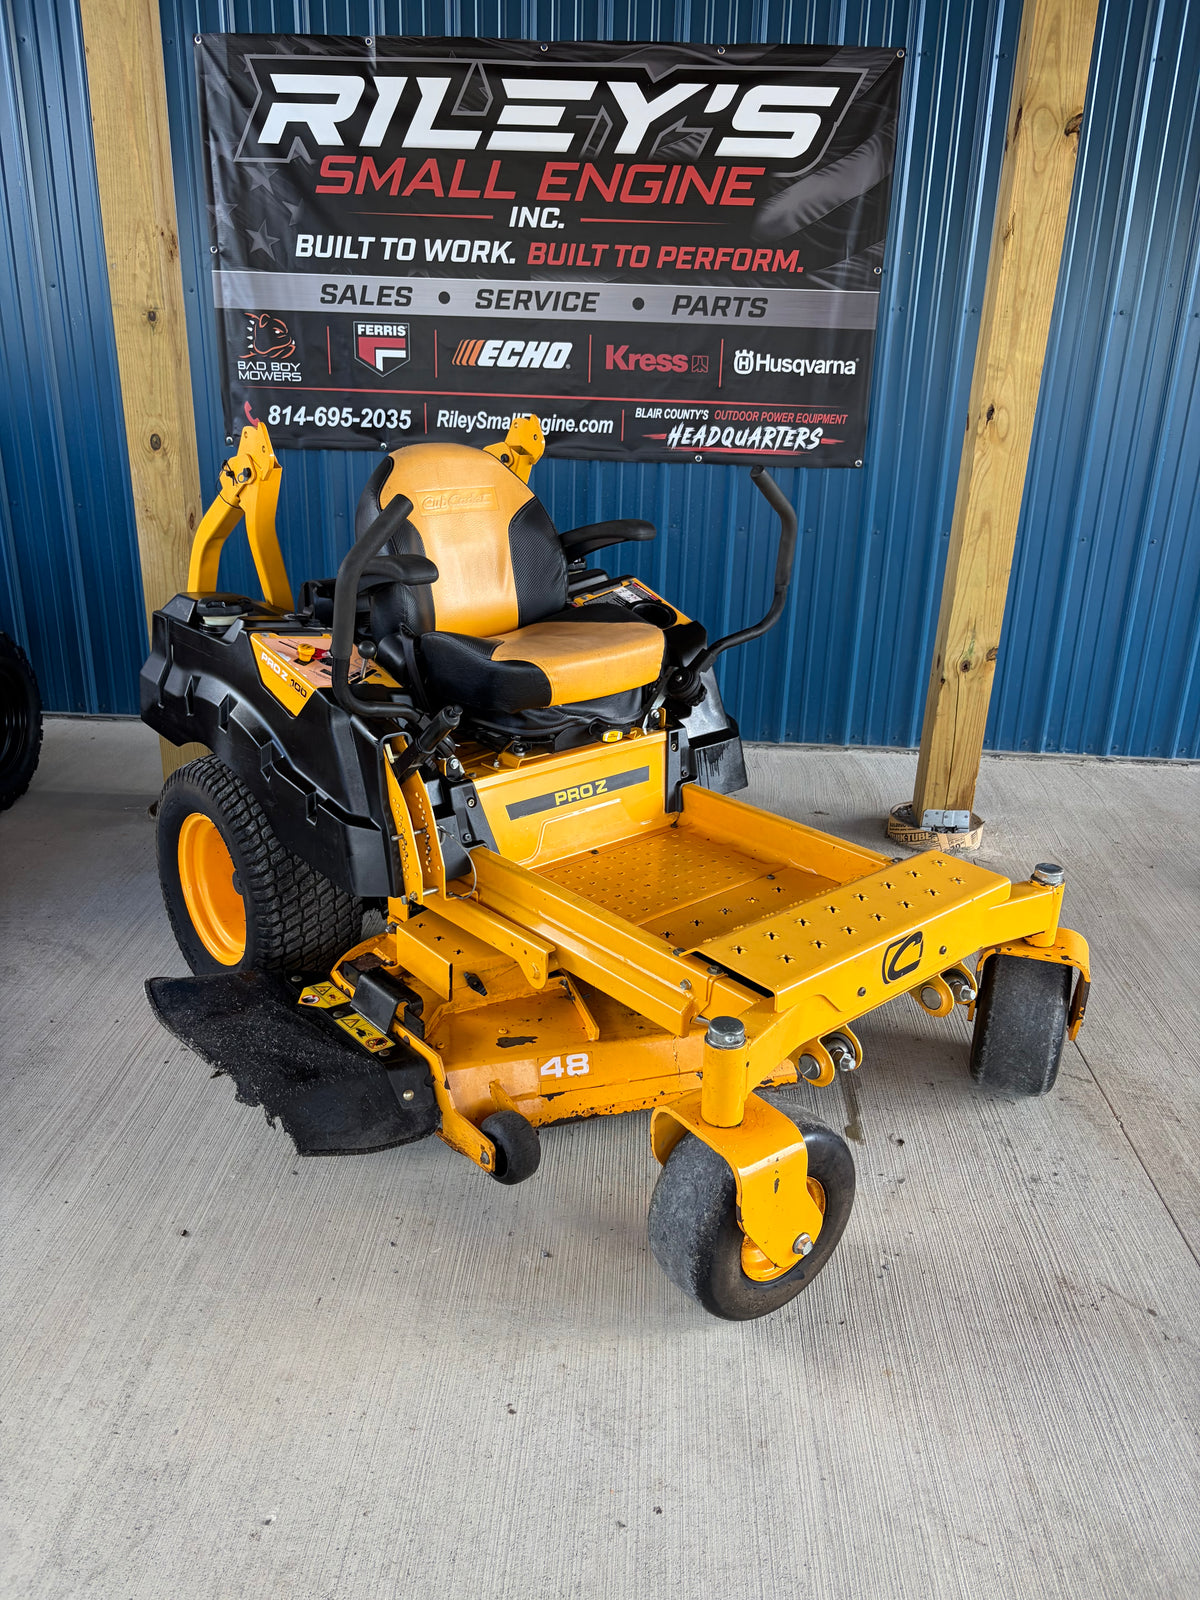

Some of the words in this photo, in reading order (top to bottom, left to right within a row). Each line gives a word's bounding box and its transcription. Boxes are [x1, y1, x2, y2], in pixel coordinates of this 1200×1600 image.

[257, 73, 841, 159] RILEY'S
[315, 155, 516, 200] SMALL
[535, 161, 766, 207] ENGINE
[509, 206, 565, 229] INC.
[295, 233, 376, 260] BUILT
[380, 237, 417, 261] TO
[424, 238, 516, 265] WORK.
[526, 242, 610, 267] BUILT
[614, 244, 651, 268] TO
[656, 245, 804, 273] PERFORM.
[319, 283, 413, 308] SALES
[474, 287, 600, 313] SERVICE
[671, 294, 769, 318] PARTS
[356, 323, 407, 338] FERRIS
[237, 360, 268, 372] BAD
[270, 362, 301, 374] BOY
[476, 338, 573, 370] ECHO
[605, 344, 688, 373] Kress
[755, 353, 856, 377] Husqvarna
[238, 370, 302, 383] MOWERS
[267, 404, 412, 431] 814-695-2035
[436, 409, 614, 436] RileySmagine.com
[634, 407, 662, 419] BLAIR
[663, 408, 710, 421] COUNTY'S
[714, 409, 760, 422] OUTDOOR
[760, 411, 795, 423] POWER
[795, 412, 849, 425] EQUIPMENT
[261, 652, 281, 674] PRO
[280, 669, 289, 682] Z
[290, 679, 308, 698] 100
[554, 783, 593, 806] PRO
[595, 779, 608, 794] Z
[540, 1052, 590, 1078] 48
